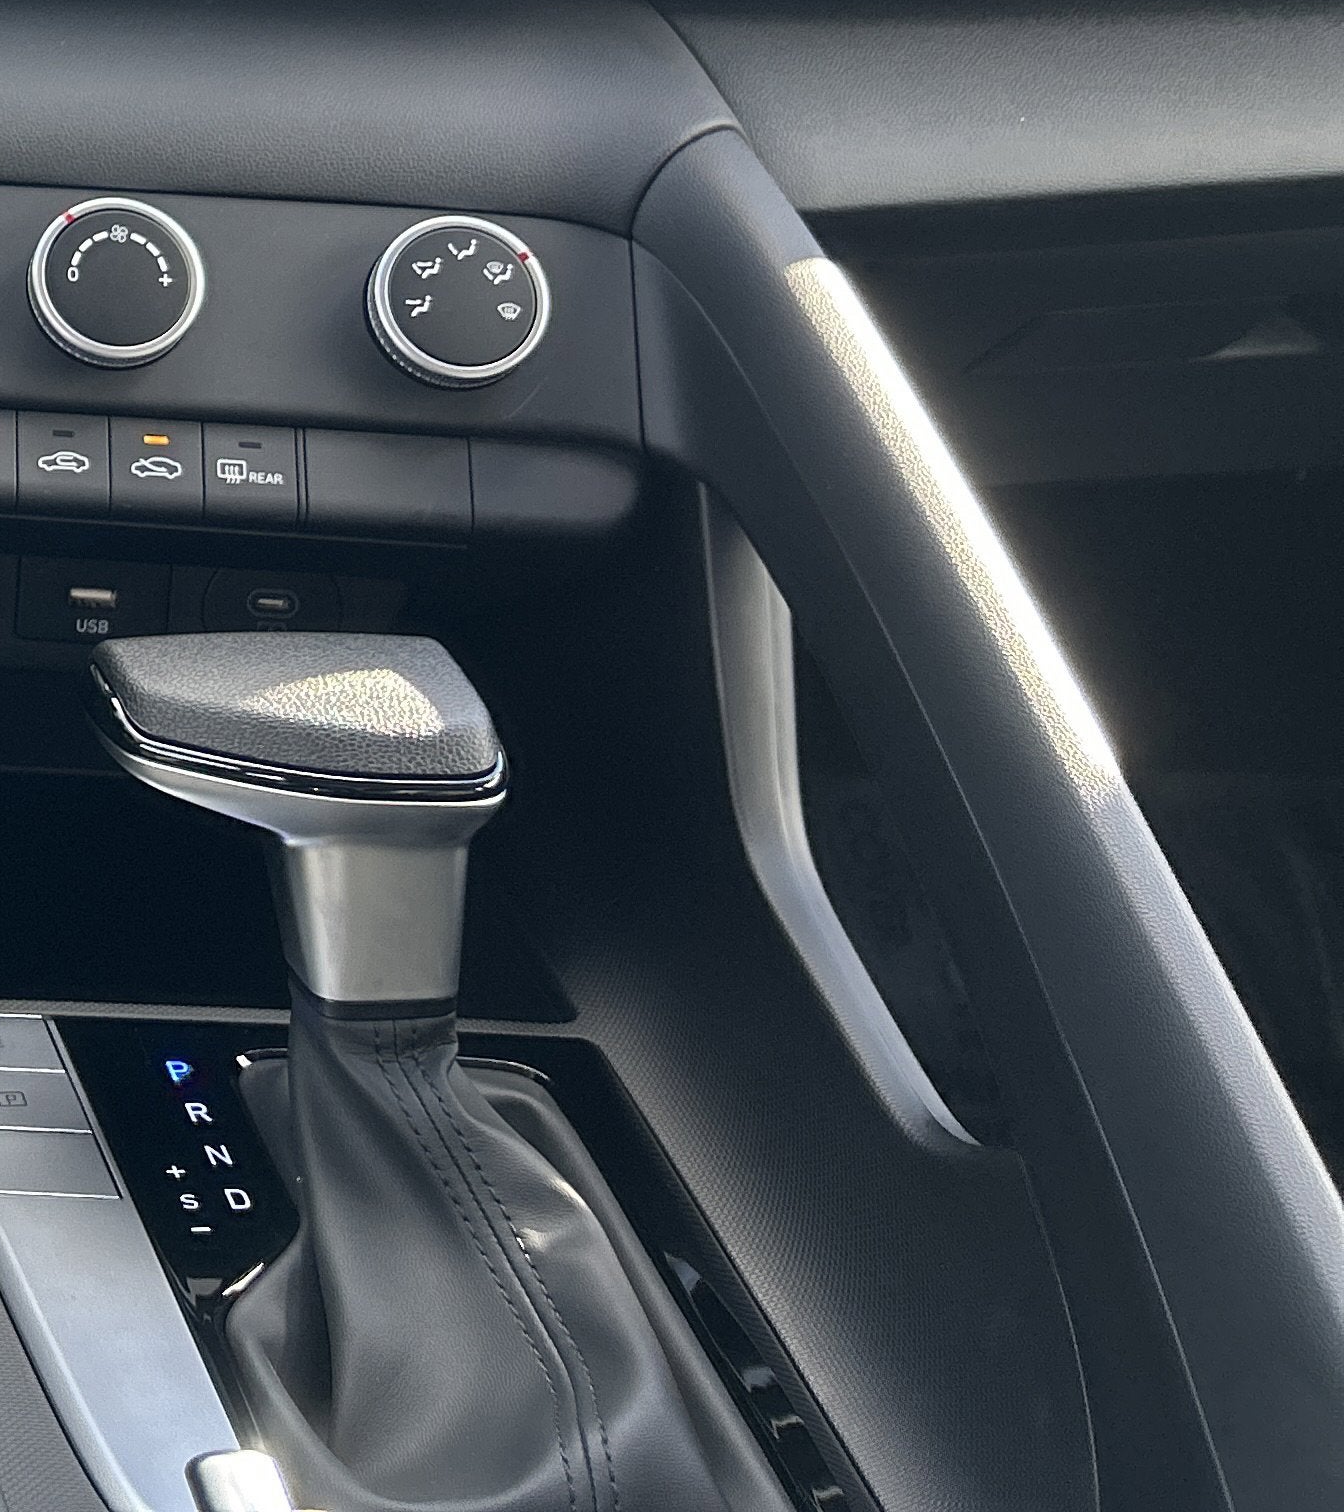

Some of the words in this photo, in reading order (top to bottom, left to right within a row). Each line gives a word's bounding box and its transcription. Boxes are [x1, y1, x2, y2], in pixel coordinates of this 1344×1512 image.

[247, 469, 284, 485] REAR
[76, 618, 109, 634] USB
[165, 1060, 190, 1083] P
[184, 1102, 213, 1123] R
[203, 1144, 233, 1166] N
[179, 1193, 199, 1210] S
[223, 1188, 252, 1210] D
